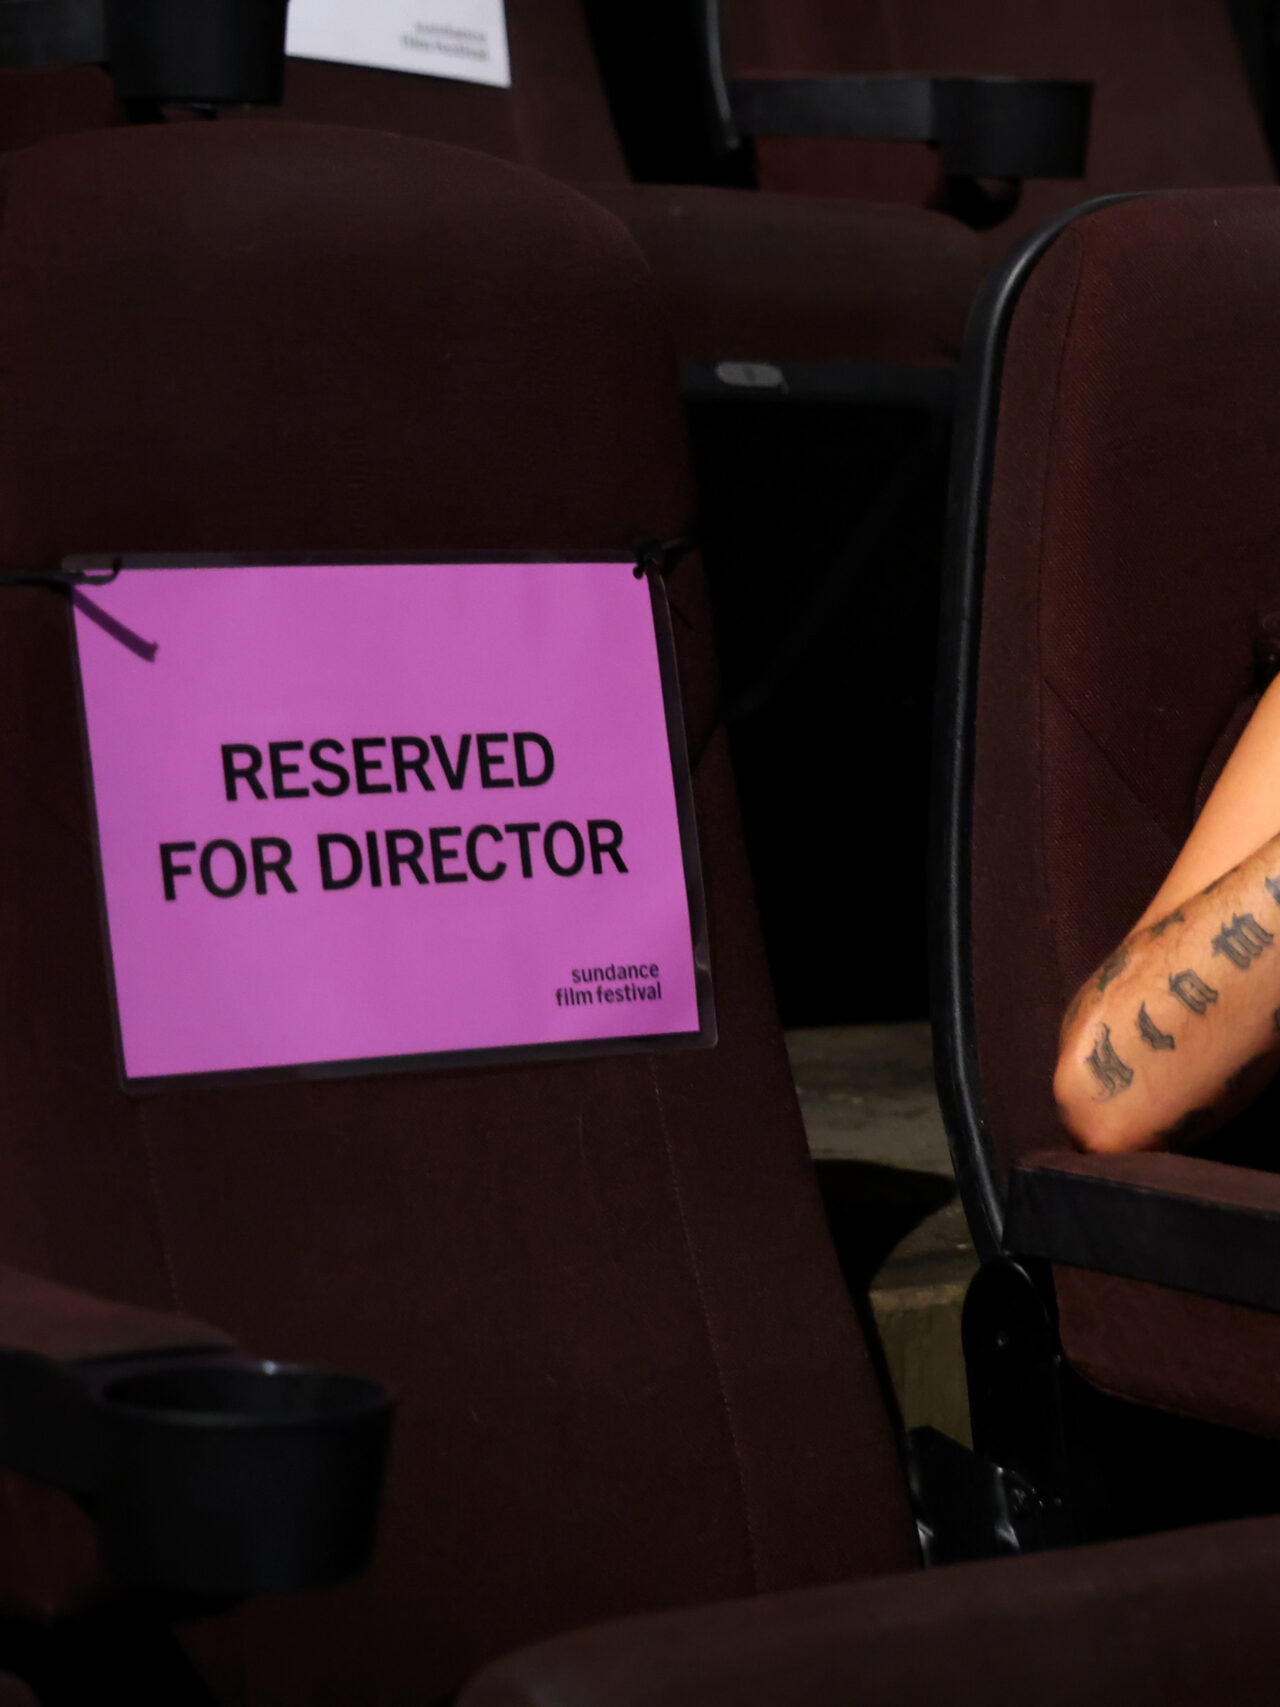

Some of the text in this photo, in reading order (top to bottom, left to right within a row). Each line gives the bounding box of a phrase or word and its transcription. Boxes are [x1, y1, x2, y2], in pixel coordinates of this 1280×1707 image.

[221, 731, 555, 801] RESERVED
[159, 818, 629, 901] FOR DIRECTOR
[556, 982, 662, 1007] film festival
[571, 963, 660, 984] sundance
